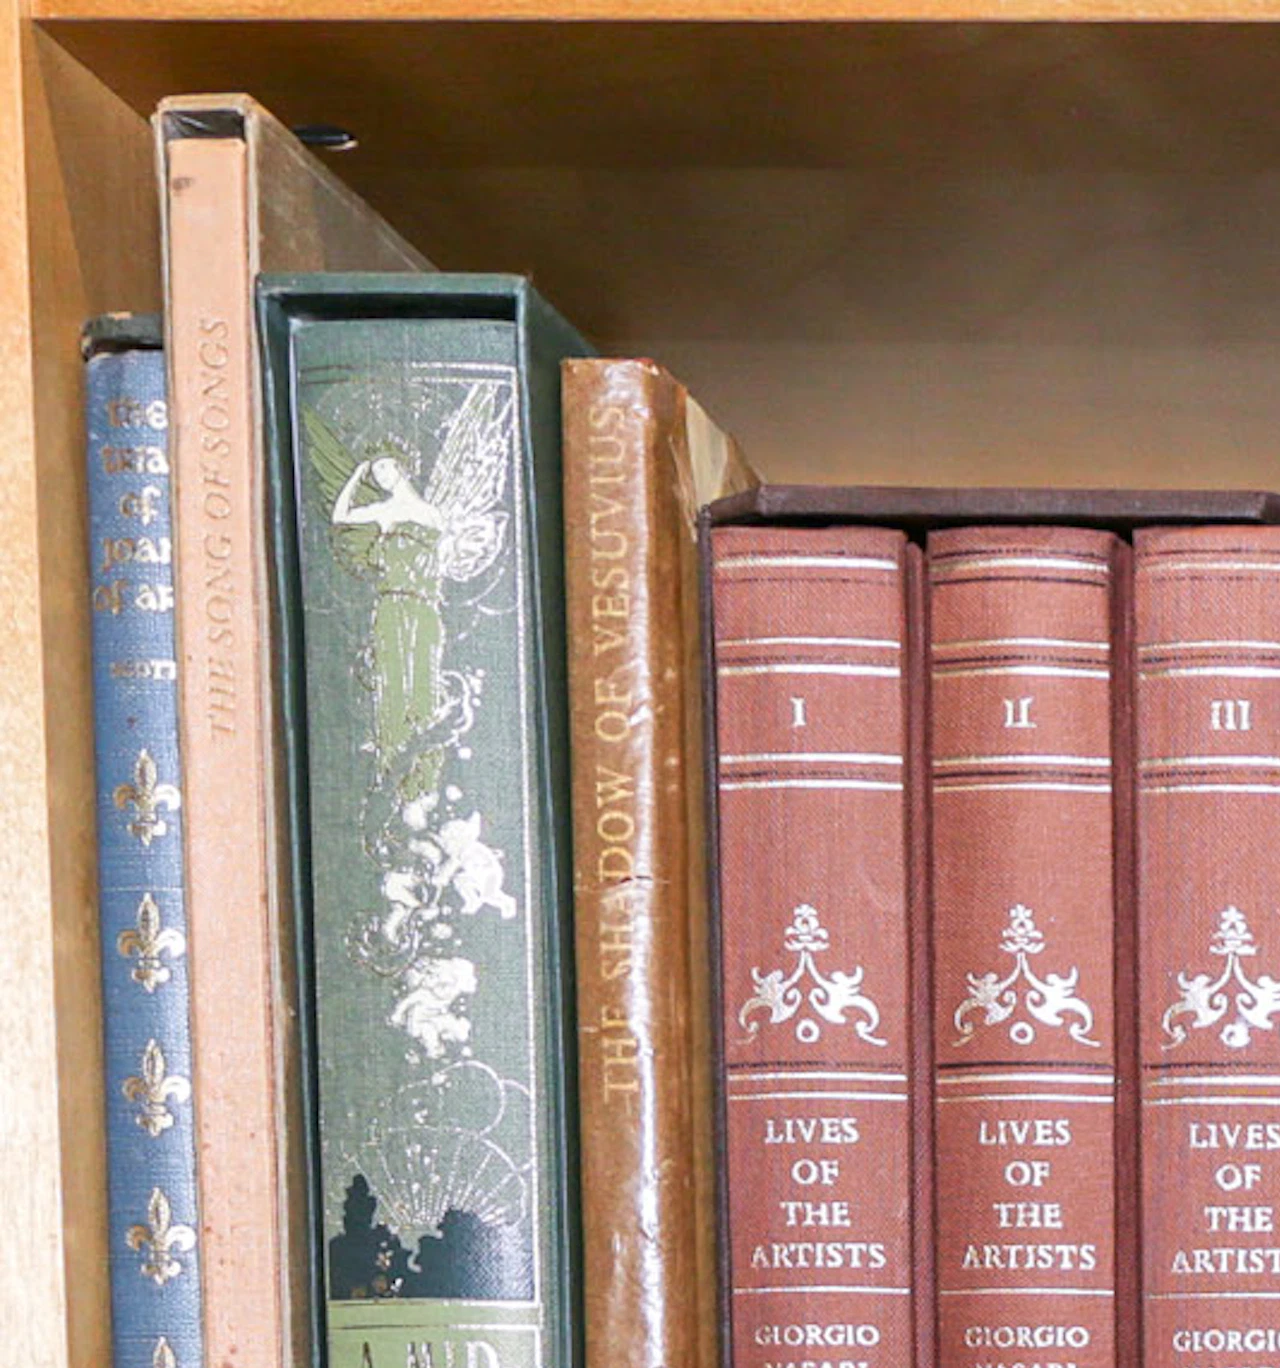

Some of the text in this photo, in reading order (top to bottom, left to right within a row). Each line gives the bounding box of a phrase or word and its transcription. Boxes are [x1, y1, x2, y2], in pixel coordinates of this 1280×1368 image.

[203, 468, 234, 650] SONG OF
[764, 1118, 859, 1145] LIVES
[979, 1119, 1072, 1146] LIVES
[792, 1160, 839, 1185] OF
[1005, 1161, 1051, 1187] OF
[1215, 1164, 1262, 1191] OF
[782, 1201, 852, 1227] THE
[993, 1203, 1063, 1229] THE
[1204, 1207, 1273, 1233] THE
[751, 1243, 887, 1269] ARTISTS
[961, 1243, 1097, 1270] ARTISTS
[755, 1324, 880, 1347] GIORGIO
[964, 1325, 1089, 1348] GIORGIO
